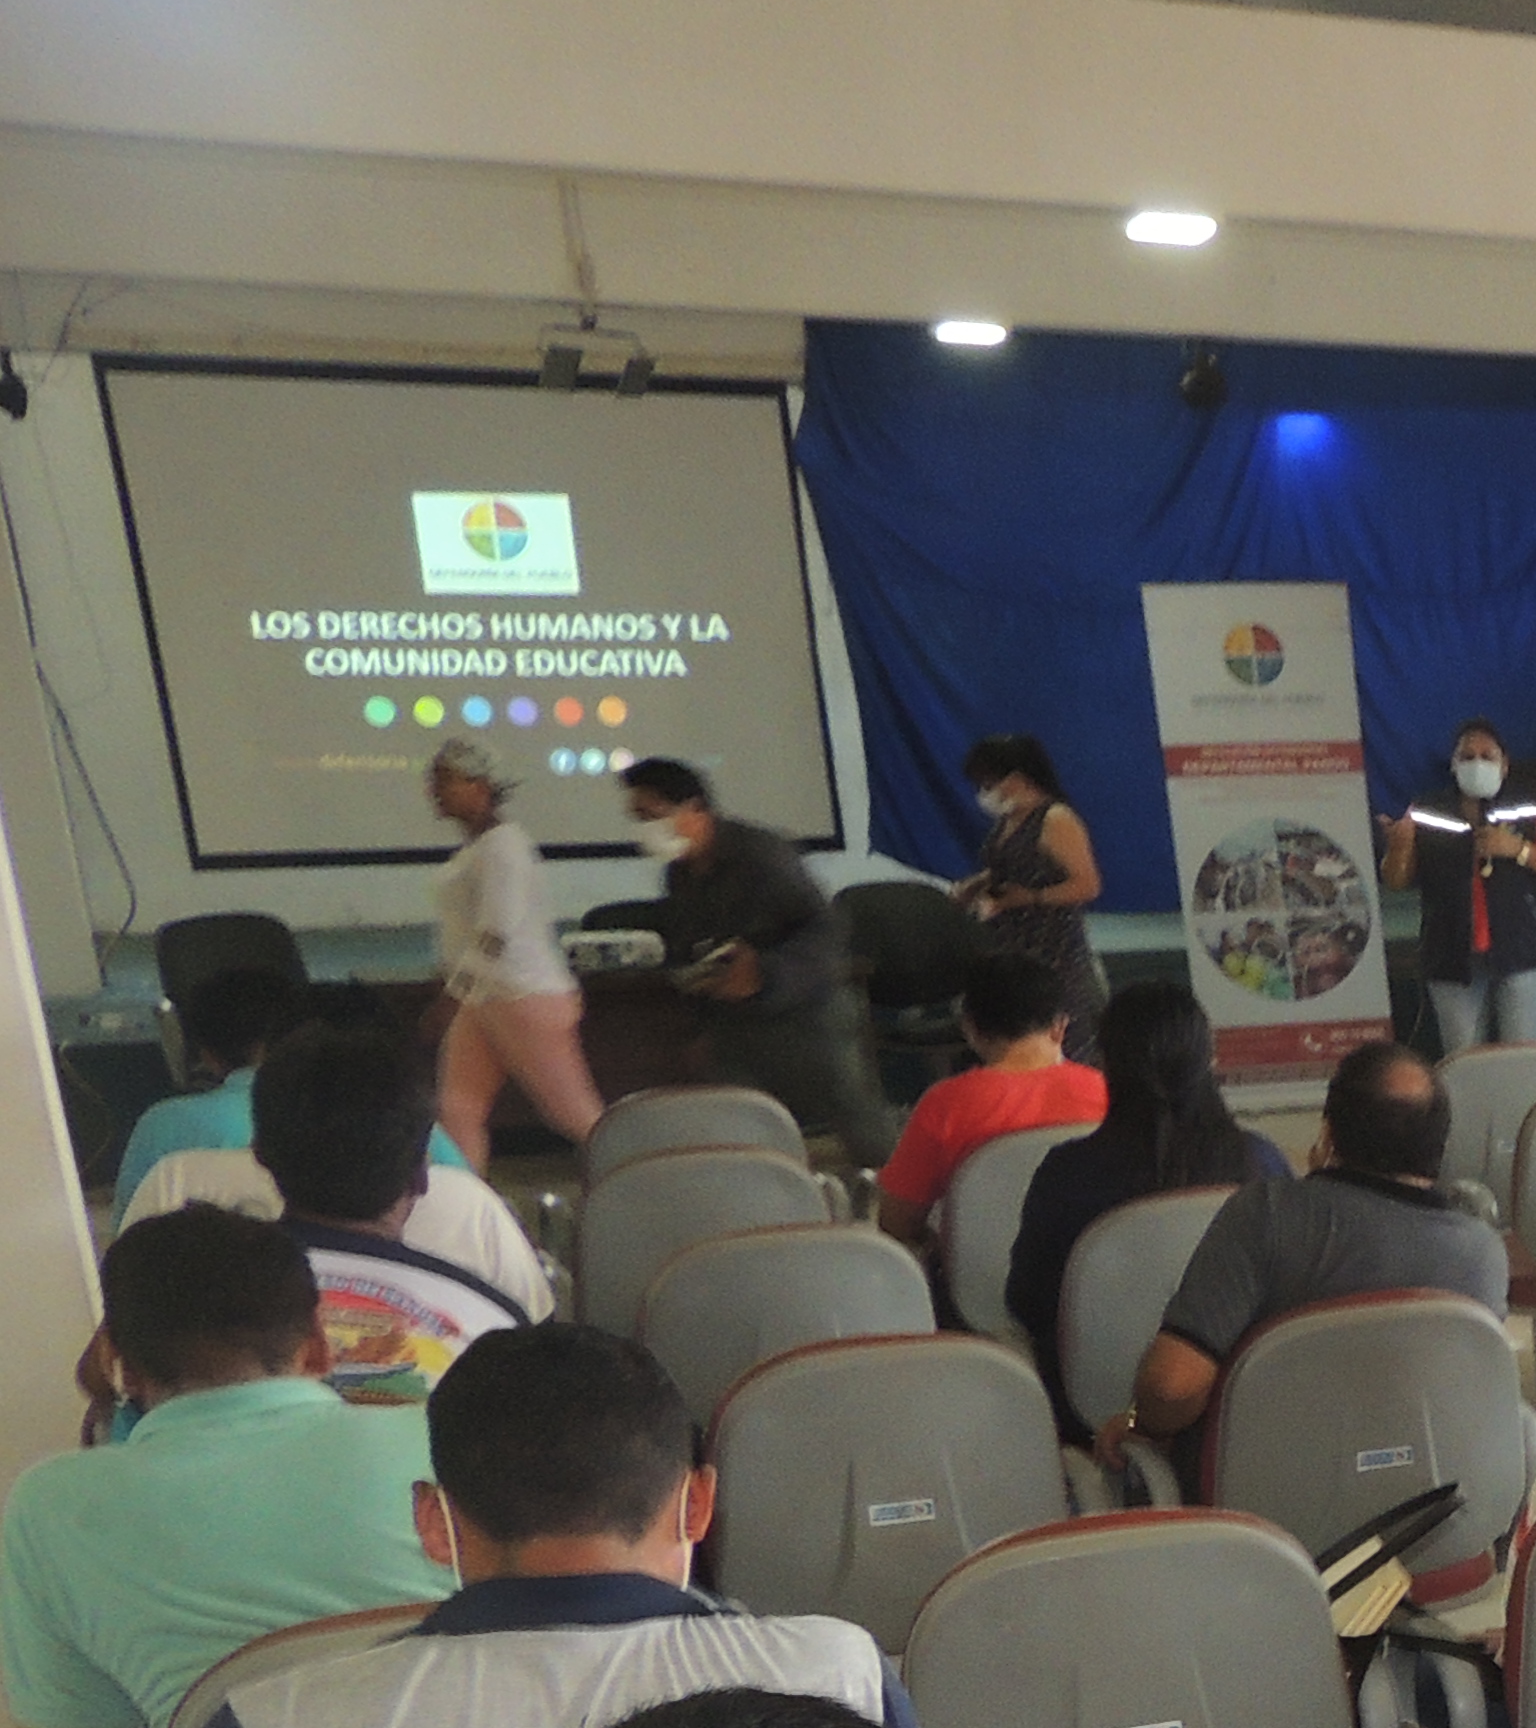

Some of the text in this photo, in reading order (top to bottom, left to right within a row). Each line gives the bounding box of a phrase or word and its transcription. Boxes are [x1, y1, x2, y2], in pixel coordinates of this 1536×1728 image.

[249, 609, 731, 643] LOS DERECHOS HUMANOS Y LA
[304, 646, 689, 678] COMUNIDAD EDUCATIVA
